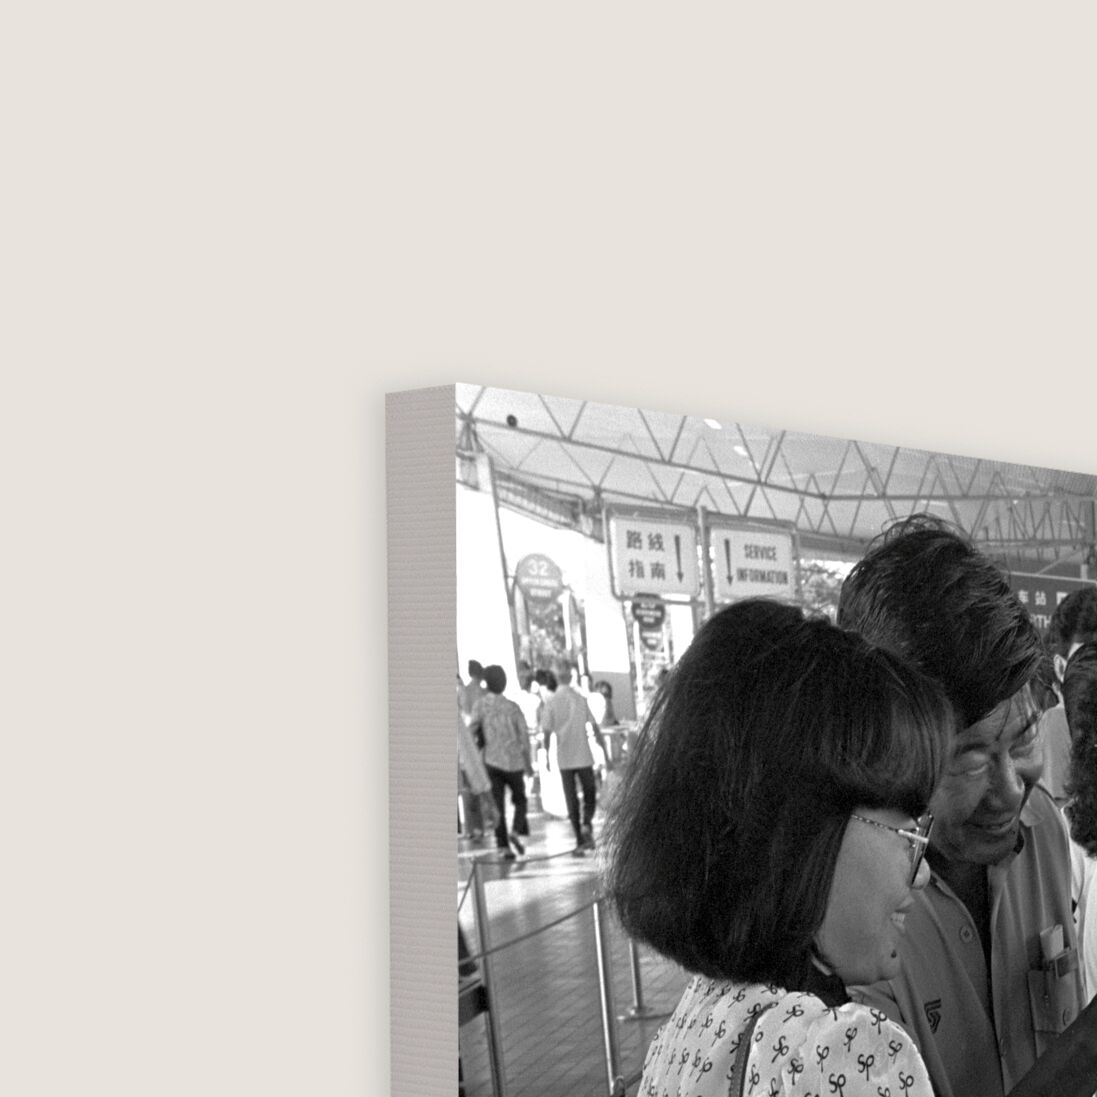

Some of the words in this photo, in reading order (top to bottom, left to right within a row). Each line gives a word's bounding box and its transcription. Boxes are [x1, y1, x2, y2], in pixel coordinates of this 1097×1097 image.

[626, 529, 665, 551] 路线
[743, 544, 777, 561] SERVICE
[528, 559, 548, 576] 32
[628, 559, 666, 580] 指南
[736, 568, 788, 585] INFORMATION
